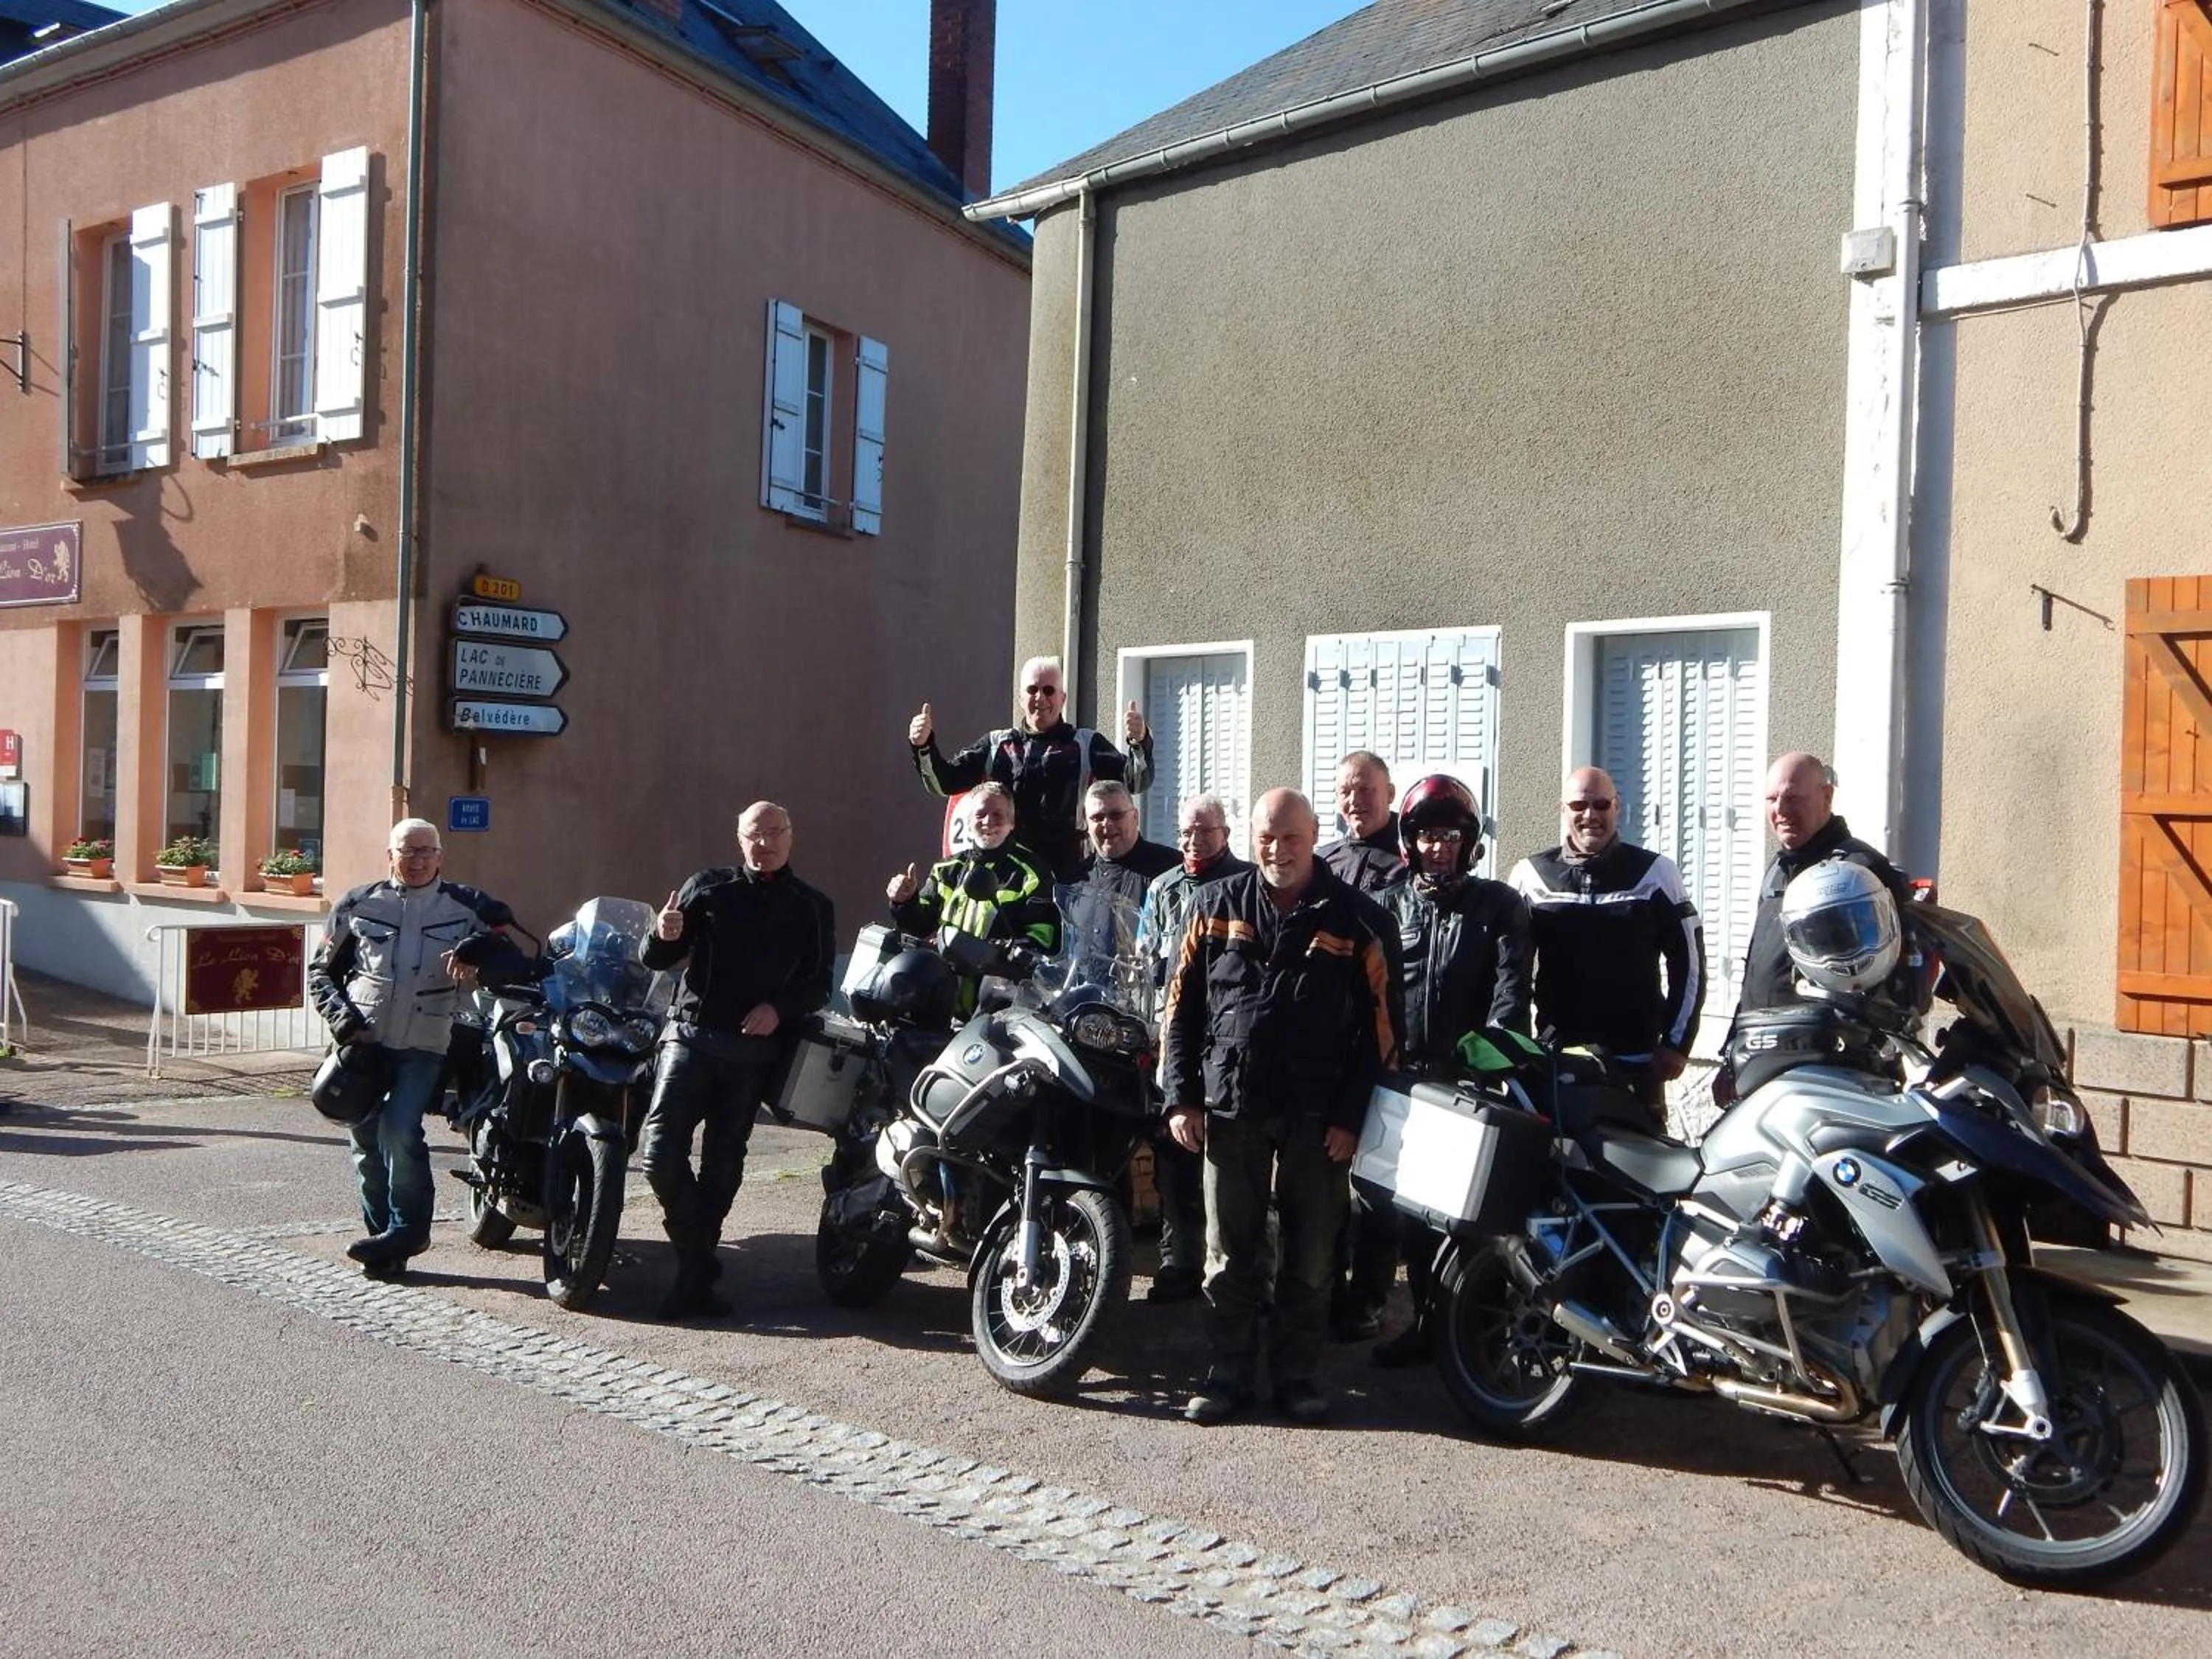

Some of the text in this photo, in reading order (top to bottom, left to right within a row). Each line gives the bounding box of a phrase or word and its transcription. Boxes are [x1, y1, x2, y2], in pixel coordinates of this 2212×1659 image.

[458, 611, 538, 631] CHAUMARD
[461, 648, 488, 664] LAC
[459, 667, 542, 691] PANNECIÈRE
[460, 708, 530, 726] Belvédère
[1745, 1034, 1778, 1050] GS
[1858, 1183, 1903, 1210] GS
